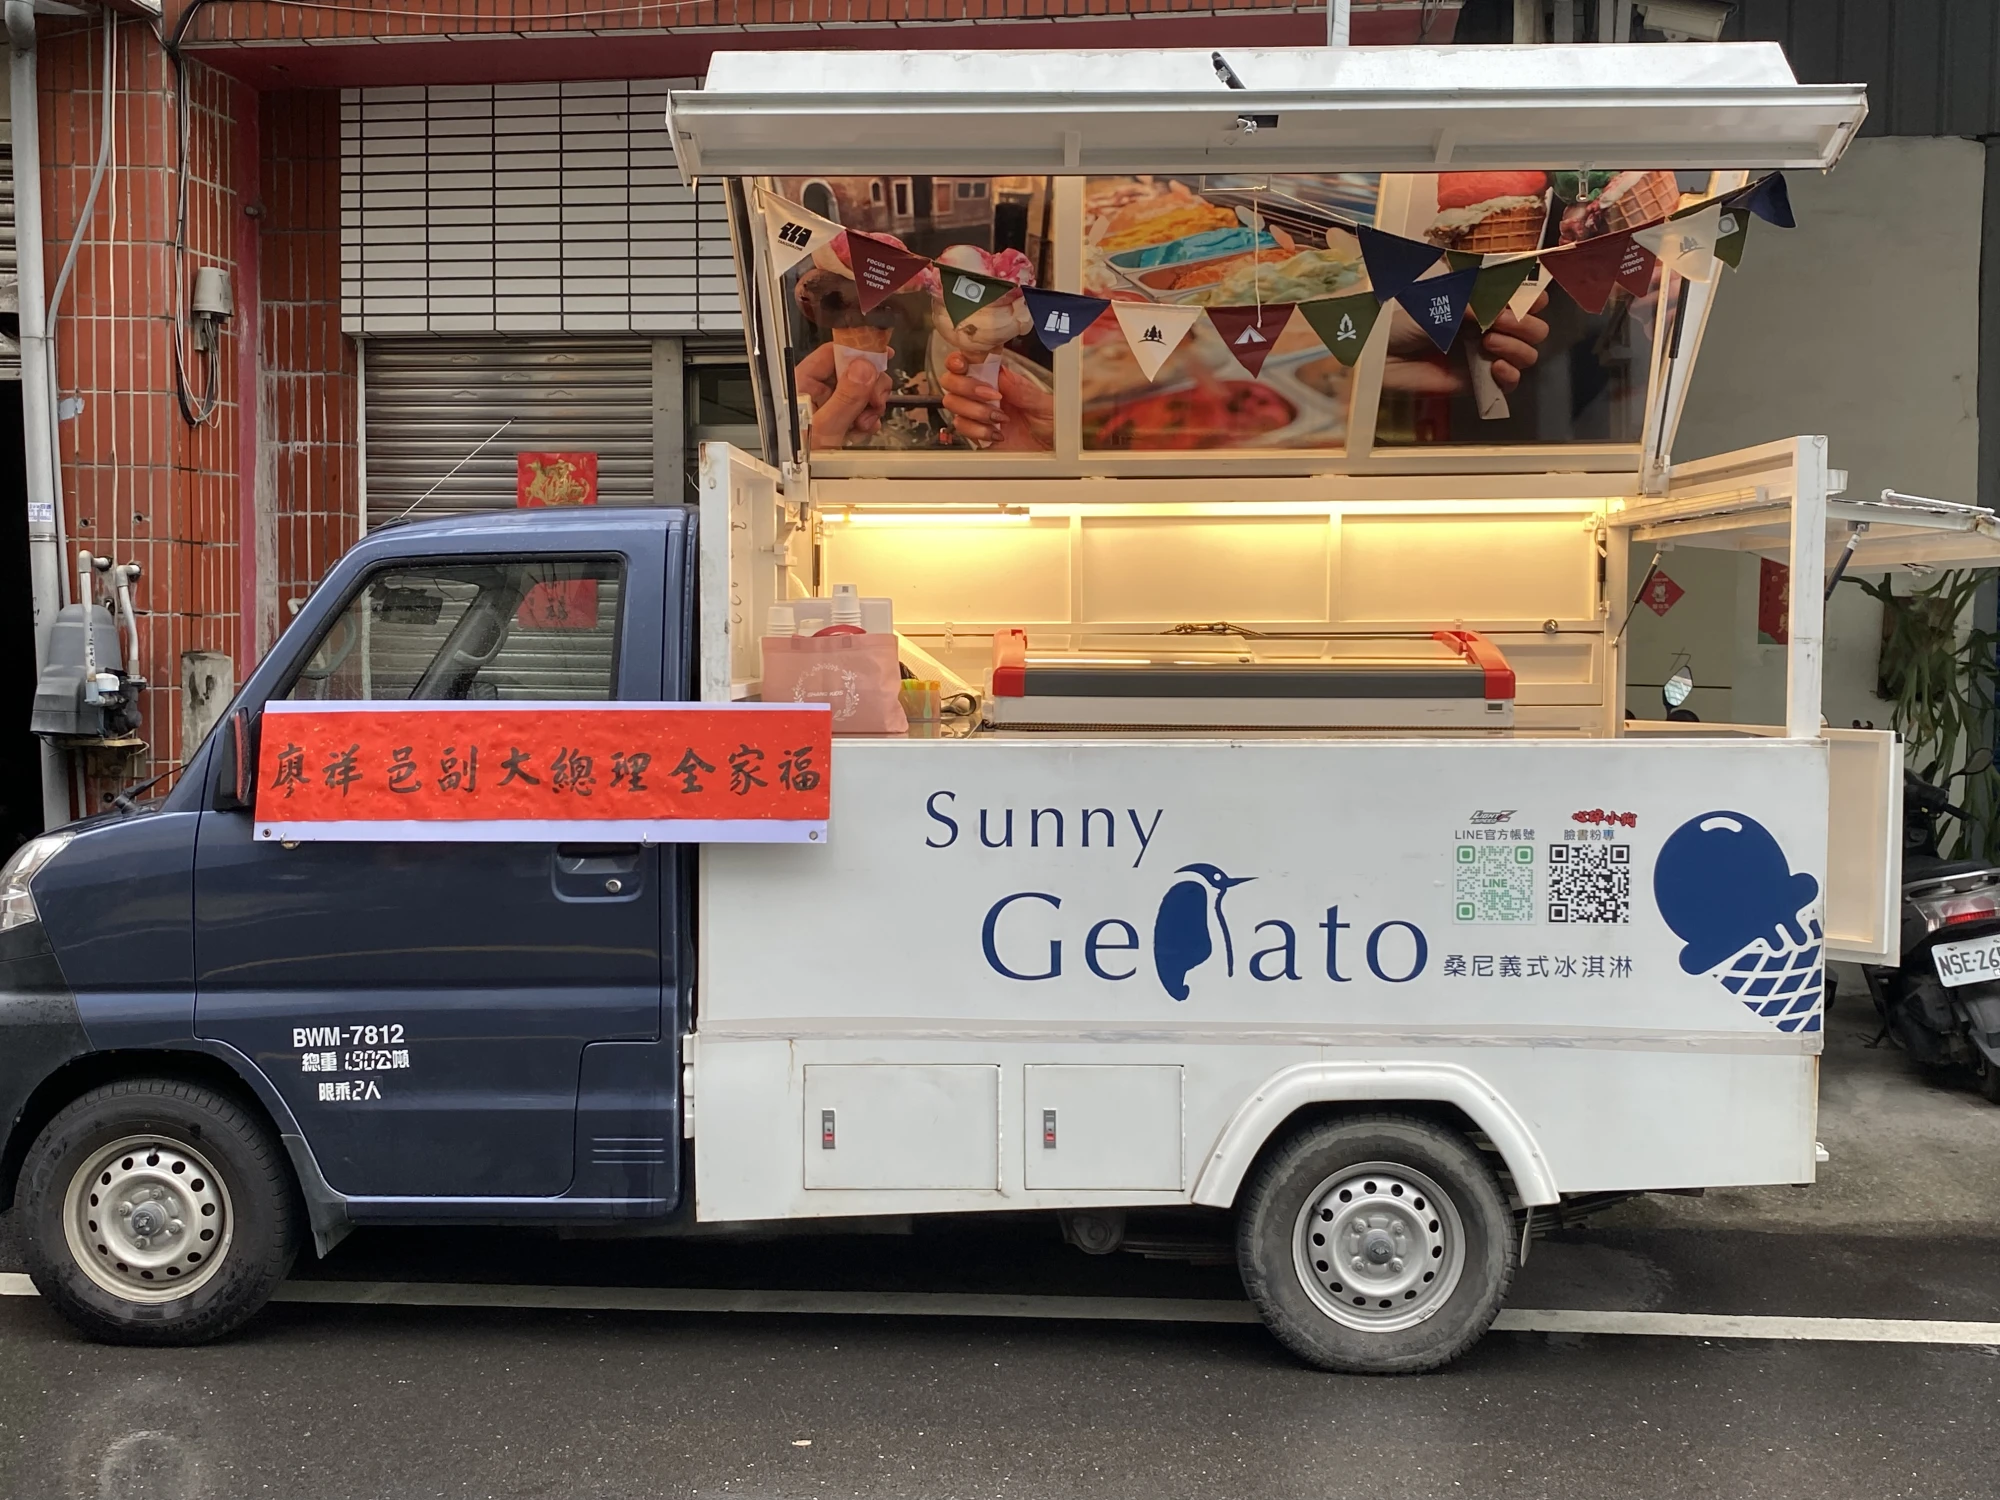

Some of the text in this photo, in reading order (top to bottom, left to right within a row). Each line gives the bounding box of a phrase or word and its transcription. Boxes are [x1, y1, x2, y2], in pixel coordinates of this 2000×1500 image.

[866, 257, 895, 272] FOCUS ON
[1620, 256, 1645, 270] UTDOOR
[863, 271, 891, 285] OUTDOOR
[868, 265, 890, 277] FAMILY
[866, 279, 885, 290] TENTS
[1431, 295, 1450, 305] TAN
[1429, 303, 1452, 317] XIAN
[1434, 312, 1453, 325] ZHE
[271, 742, 822, 800] 廖祥邑副大總理全家福
[924, 789, 1164, 869] Sunny
[1454, 829, 1536, 841] LINE官方帳號
[1563, 828, 1615, 842] 臉書粉專
[1482, 879, 1508, 888] LINE
[1443, 954, 1633, 978] 桑尼義式冰淇淋
[292, 1023, 405, 1048] BWM-7812
